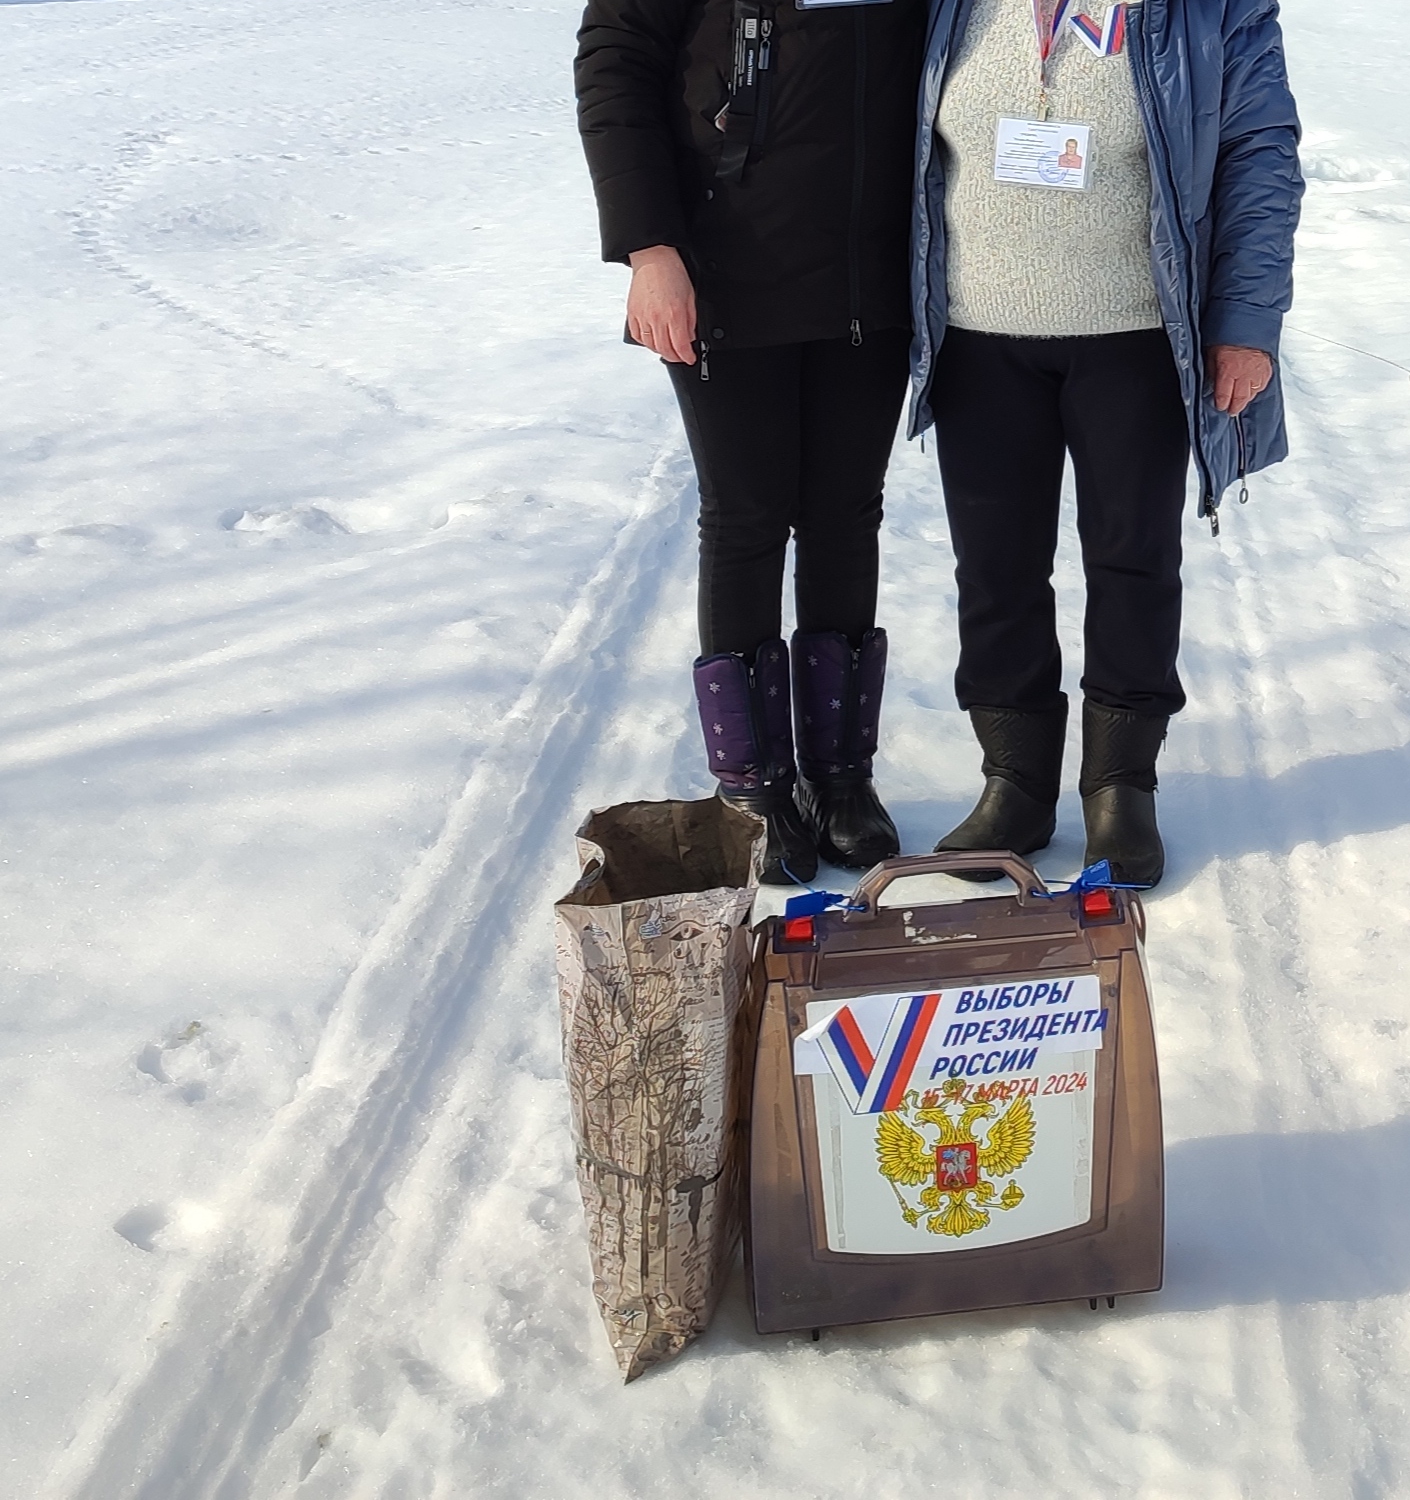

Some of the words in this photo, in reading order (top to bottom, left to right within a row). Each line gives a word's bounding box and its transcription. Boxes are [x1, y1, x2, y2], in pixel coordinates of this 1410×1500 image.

[955, 980, 1075, 1014] ВЫБОРЫ
[942, 1008, 1108, 1048] ПРЕЗИДЕНТА
[929, 1047, 1039, 1080] РОССИИ
[1041, 1071, 1088, 1096] 2024
